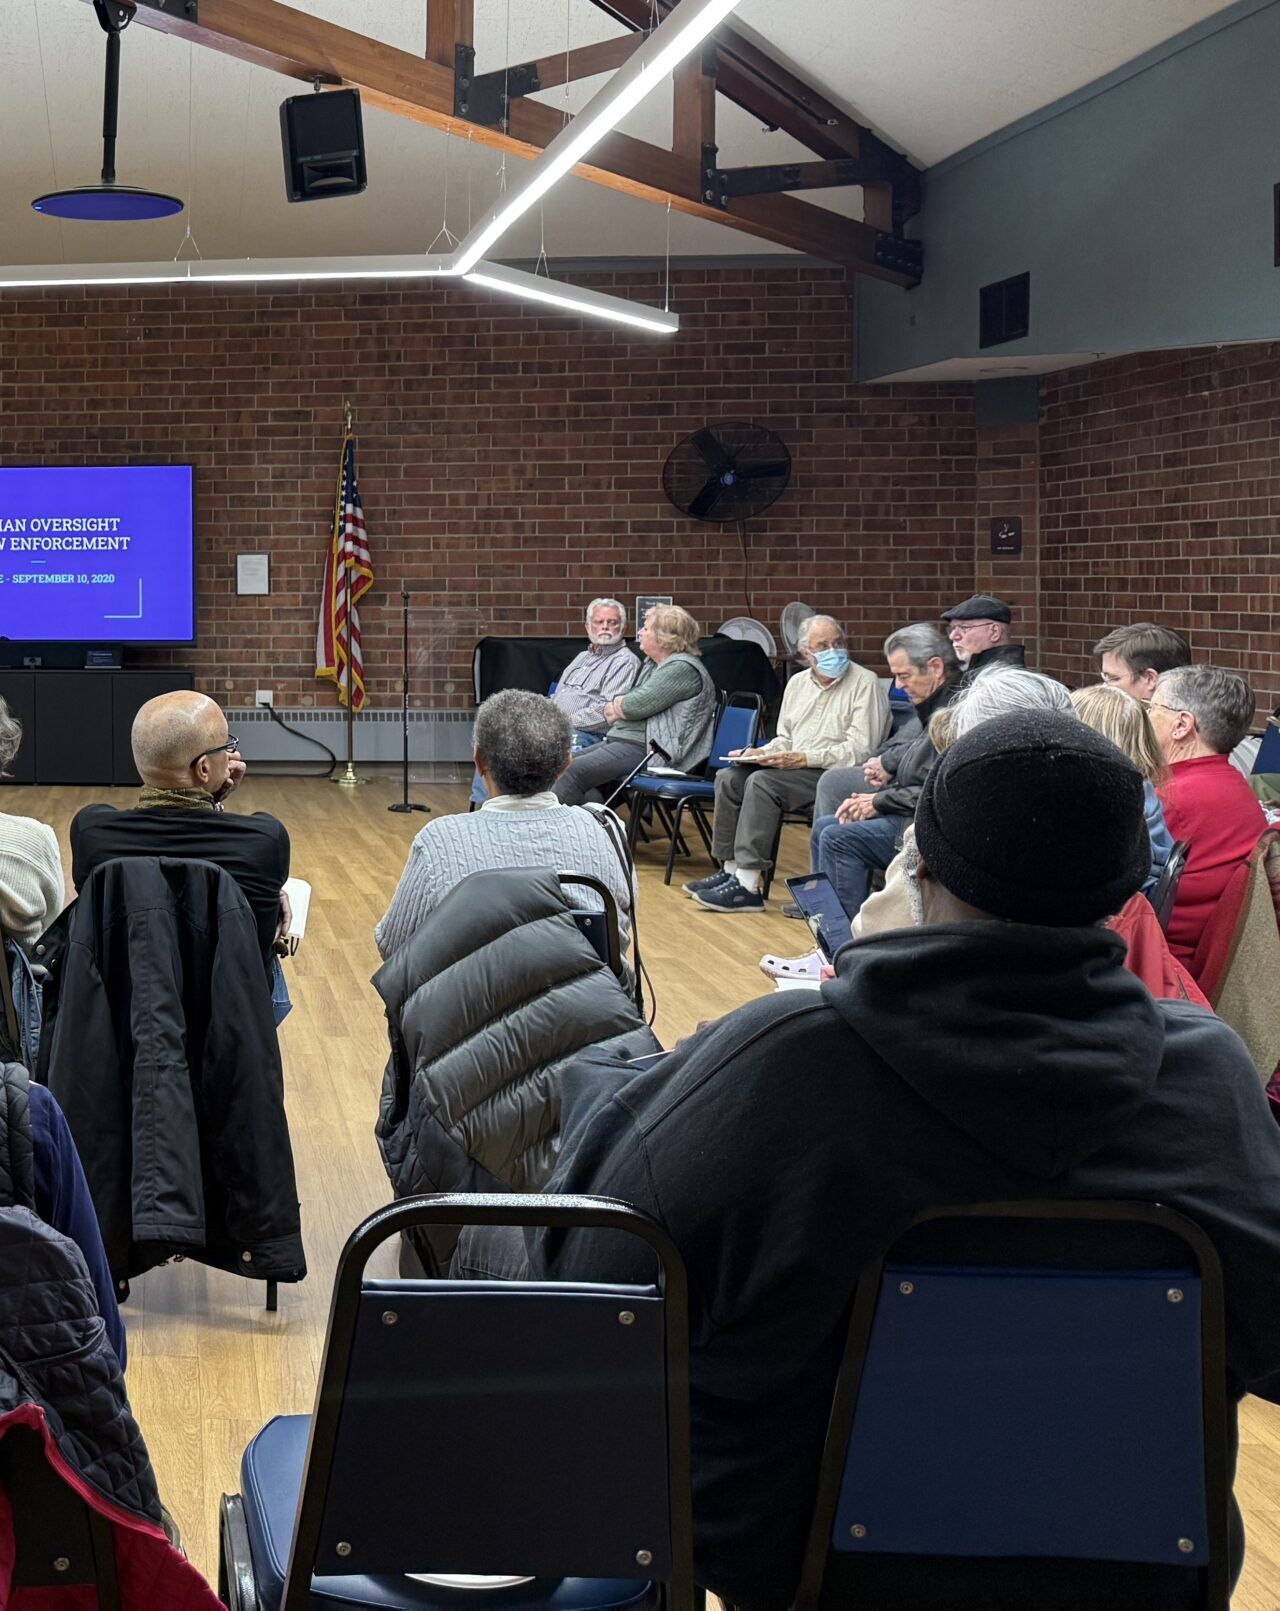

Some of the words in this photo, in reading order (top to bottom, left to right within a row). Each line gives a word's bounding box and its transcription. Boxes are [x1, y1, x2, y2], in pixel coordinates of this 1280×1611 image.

[30, 518, 121, 532] OVERSIGHT
[9, 536, 131, 550] ENFORCEMENT
[12, 574, 75, 584] SEPTEMBER
[77, 574, 90, 585] 10,
[91, 574, 115, 584] 2020
